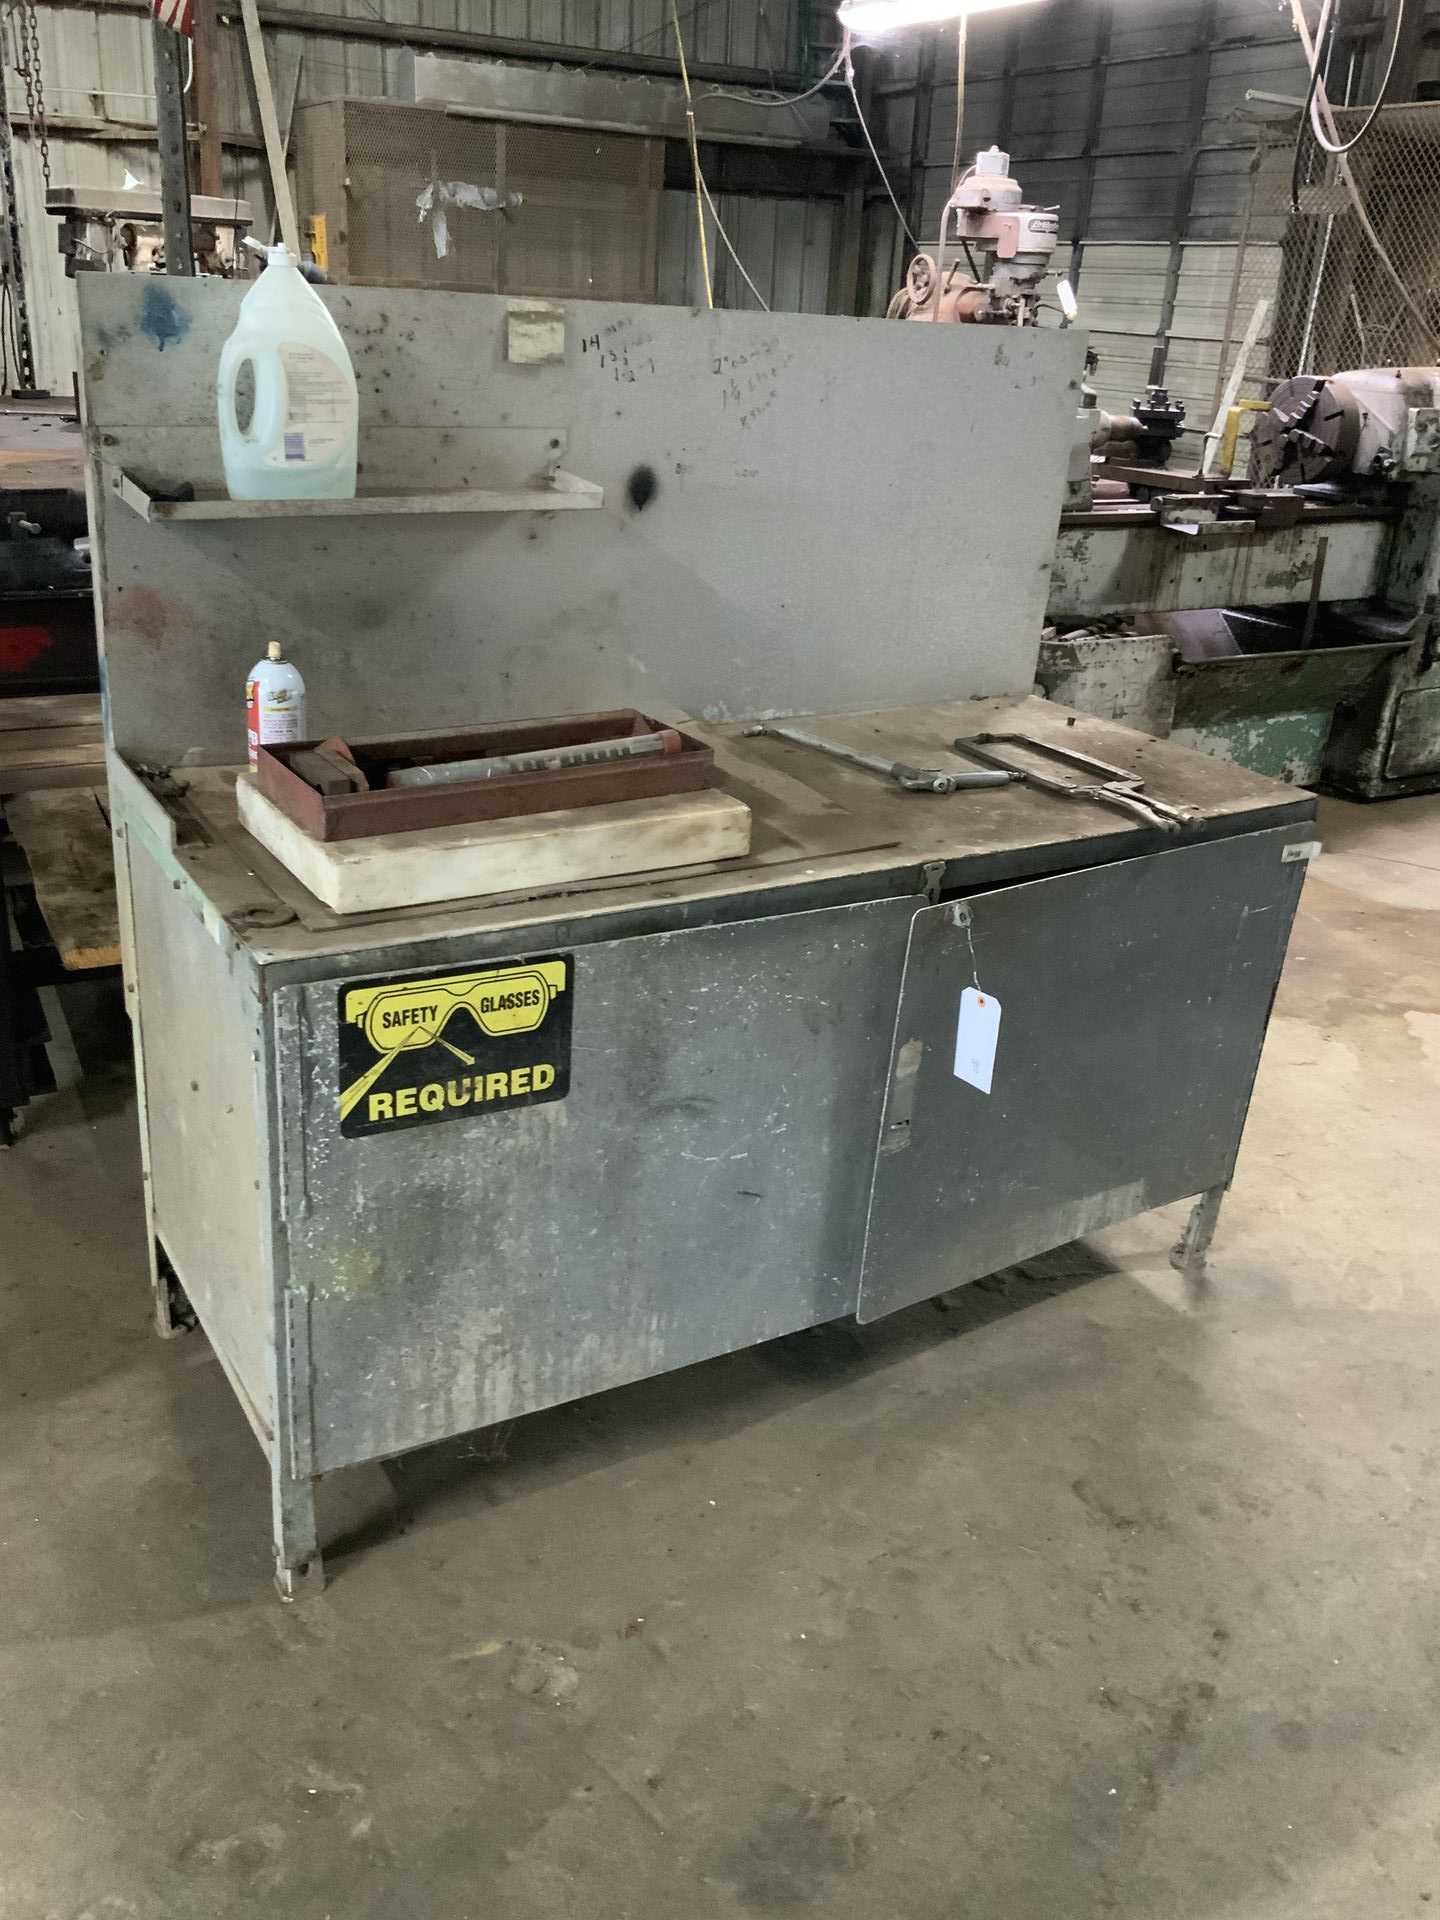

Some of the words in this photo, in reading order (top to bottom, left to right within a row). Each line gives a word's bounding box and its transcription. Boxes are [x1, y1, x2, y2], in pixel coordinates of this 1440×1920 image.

[382, 1005, 438, 1029] SAFETY
[480, 989, 540, 1014] GLASSES
[368, 1063, 556, 1121] REQUIRED
